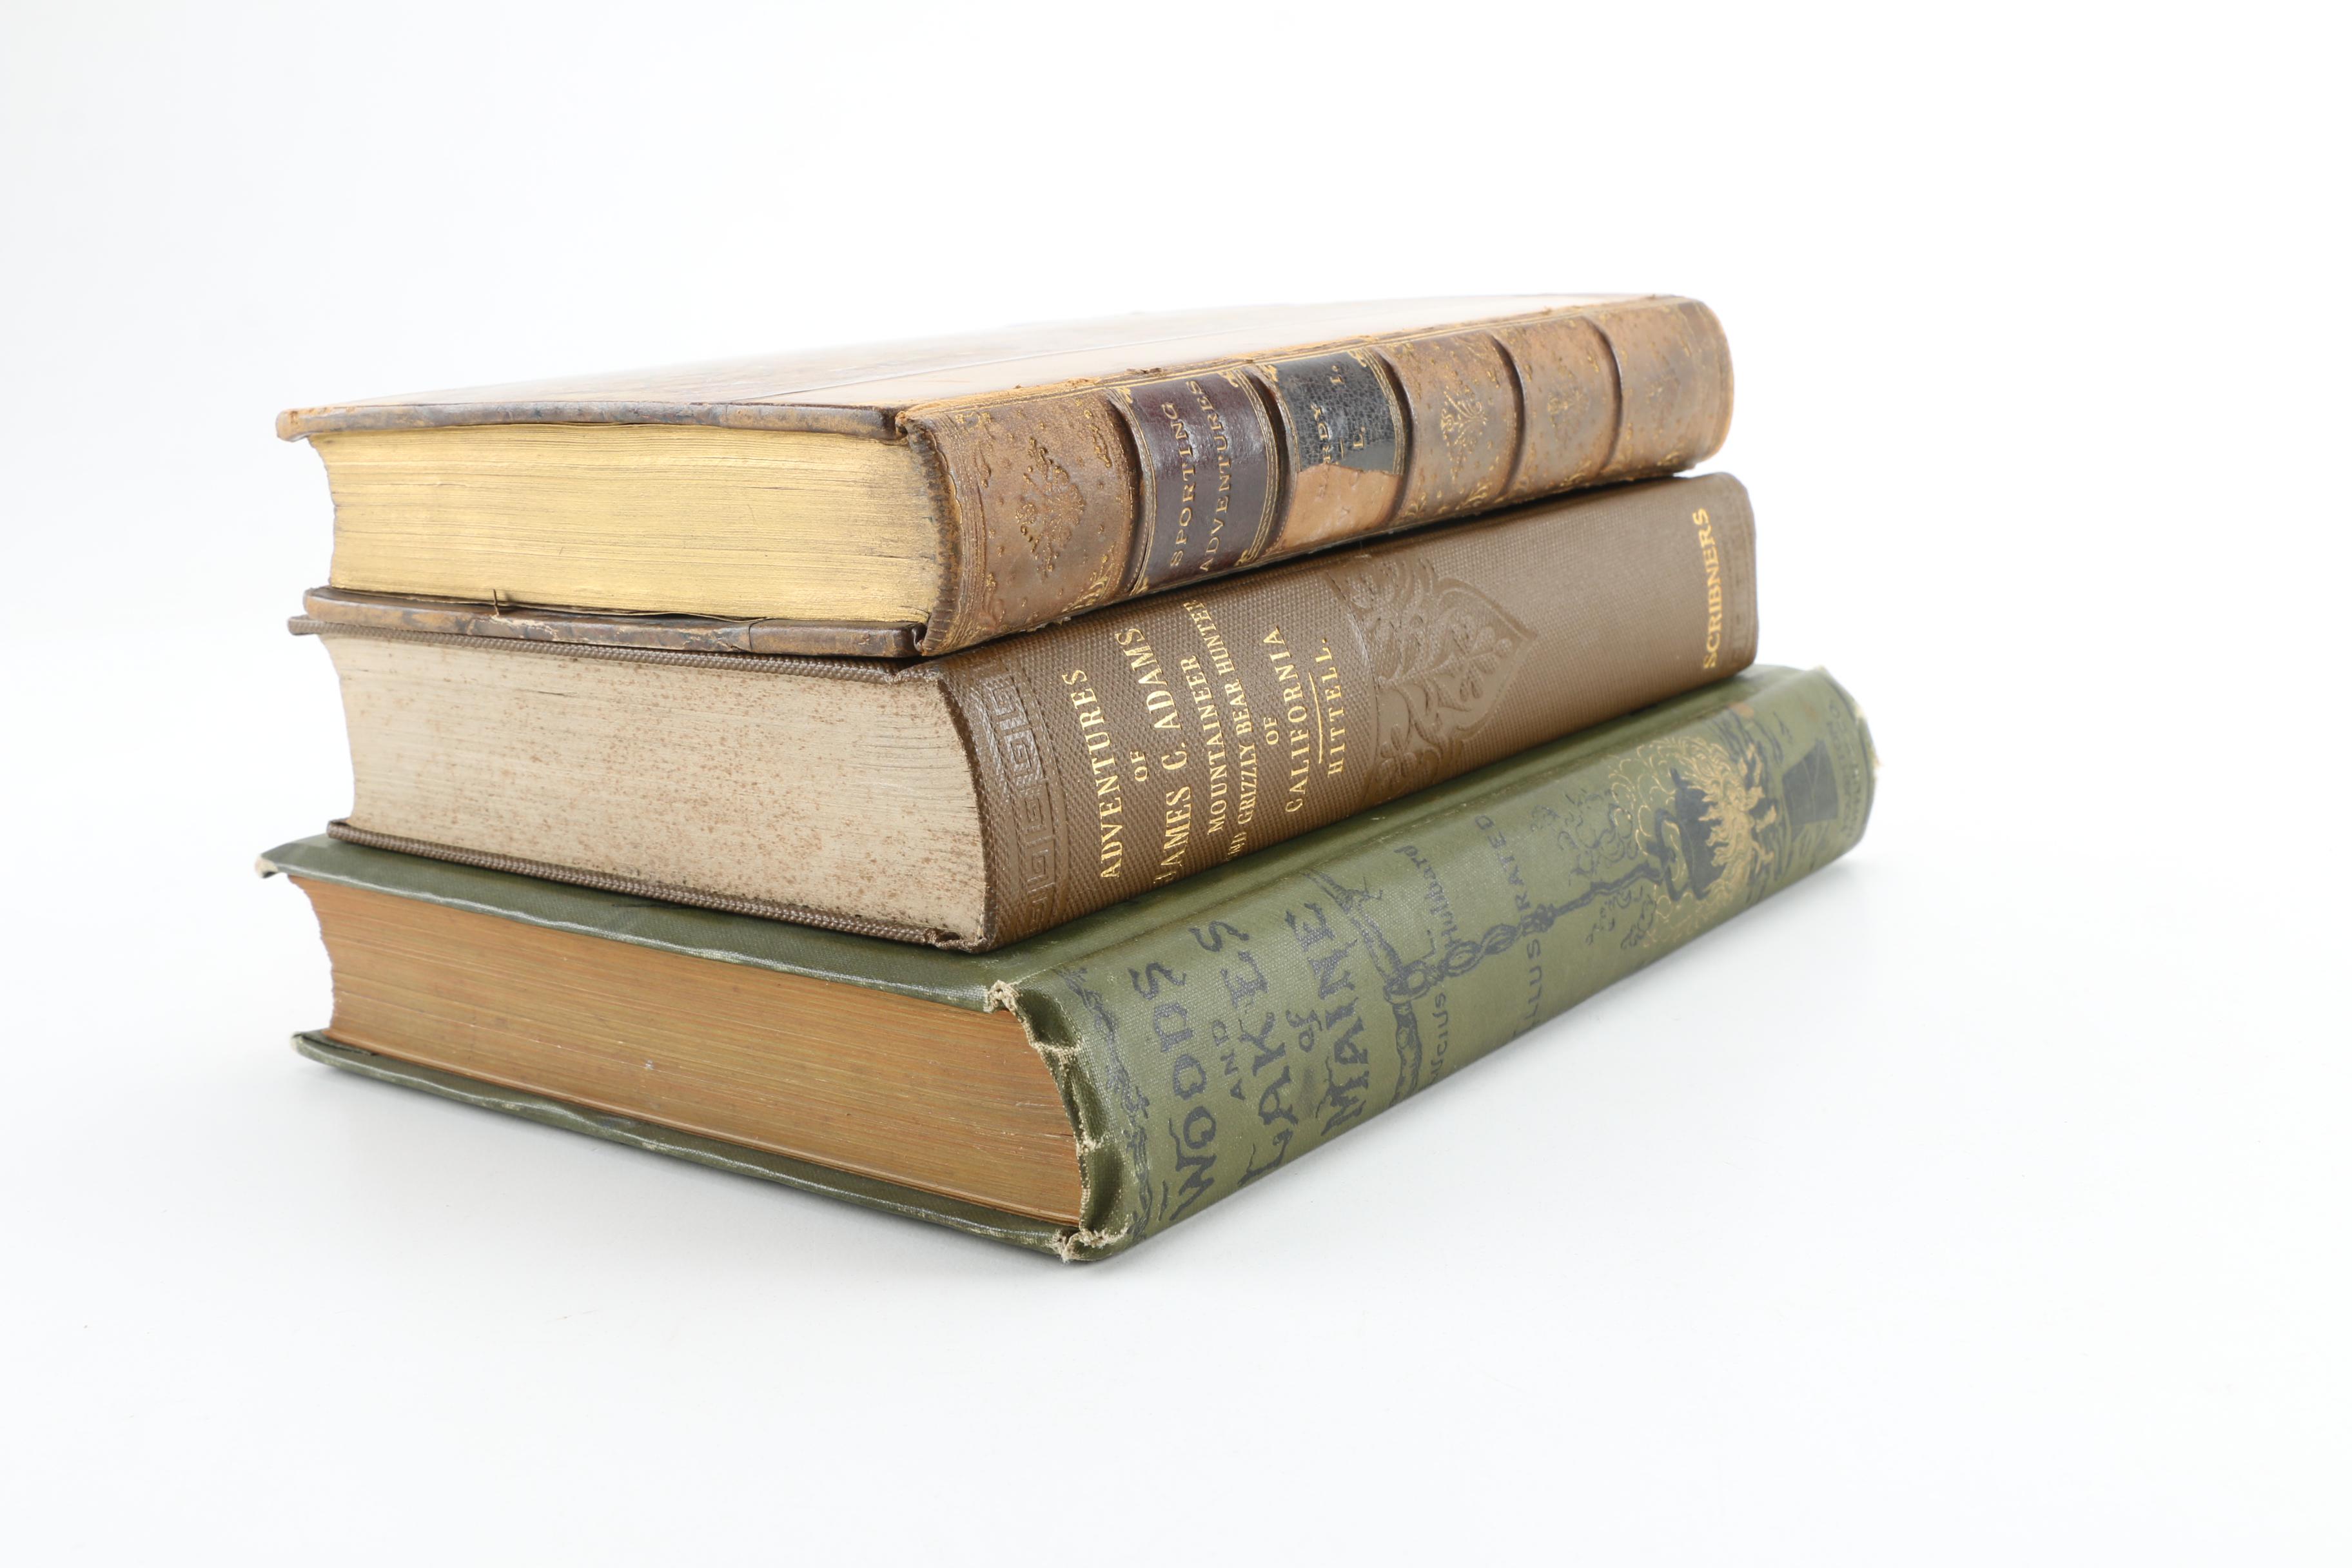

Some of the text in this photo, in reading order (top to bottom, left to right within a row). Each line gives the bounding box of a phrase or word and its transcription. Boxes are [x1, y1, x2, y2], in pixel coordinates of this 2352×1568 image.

[1162, 402, 1197, 567] SPORTING
[1186, 379, 1232, 572] ADVENTURES
[1692, 507, 1723, 669] SCRIBNERS
[1063, 669, 1122, 879] ADVENTURES
[1115, 627, 1191, 885] JAMES C. ADAMS
[1130, 750, 1148, 782] OF
[1181, 654, 1228, 836] MOUNTAINEER
[1224, 678, 1253, 735] BEAR
[1238, 743, 1258, 825] GRIZZLY
[1263, 625, 1309, 813] CALIFORNIA
[1264, 716, 1279, 746] OF
[1315, 638, 1347, 778] HITTELL.
[1130, 961, 1217, 1220] WOODS
[1190, 920, 1298, 1186] LAKES
[1284, 902, 1369, 1136] MAINE
